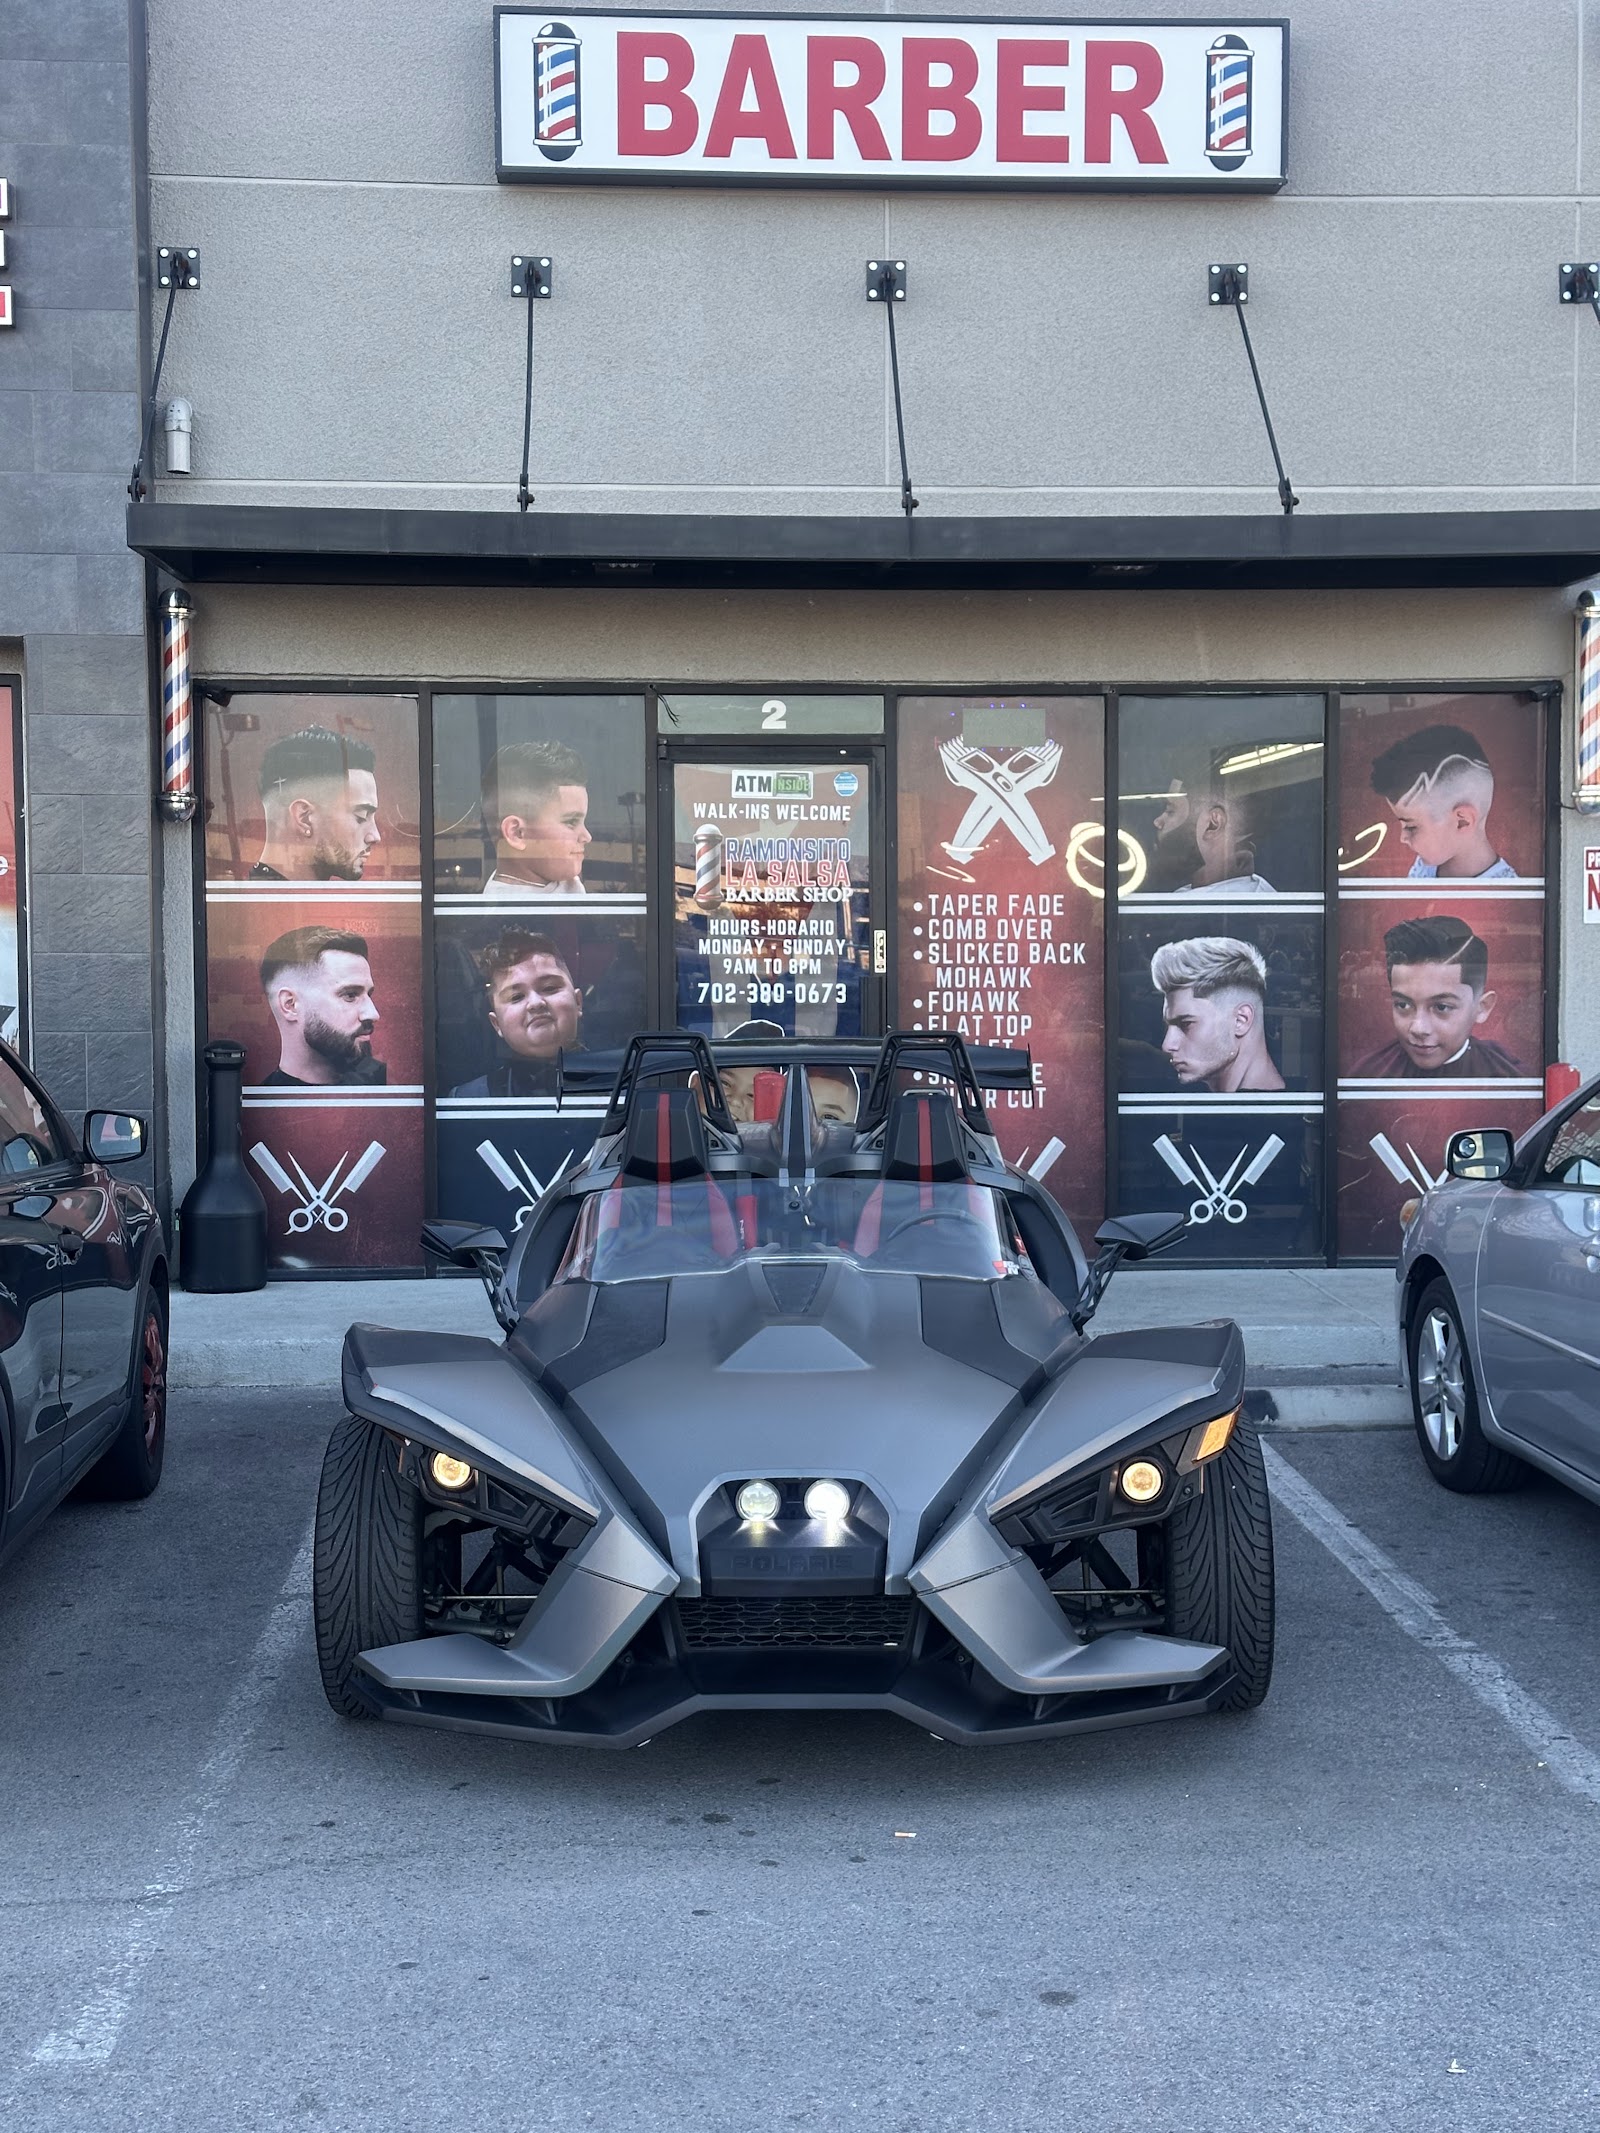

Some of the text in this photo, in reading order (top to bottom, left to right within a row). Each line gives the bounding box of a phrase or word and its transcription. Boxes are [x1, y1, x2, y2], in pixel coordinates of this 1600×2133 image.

[616, 31, 1169, 164] BARBER
[761, 700, 787, 729] 2
[735, 775, 772, 793] ATM
[693, 803, 851, 821] WALK-INS WELCOME
[725, 837, 851, 863] RAMONSITO
[725, 859, 851, 887] LA SALSA
[725, 886, 854, 903] BARBER SHOP
[928, 894, 1065, 916] TAPER FADE
[709, 919, 835, 936] HOURS-HORARIO
[928, 918, 1052, 940] COMB OVER
[698, 938, 765, 955] MONDAY
[783, 938, 846, 955] SUNDAY
[928, 942, 1086, 964] SLICKED BACK
[723, 958, 822, 975] 9AM TO 8PM
[936, 966, 1032, 988] MOHAWK
[697, 982, 848, 1004] 702-380-0673
[928, 991, 1020, 1013] FOHAWK
[993, 1015, 1032, 1037] TOP
[1007, 1087, 1046, 1109] CUT
